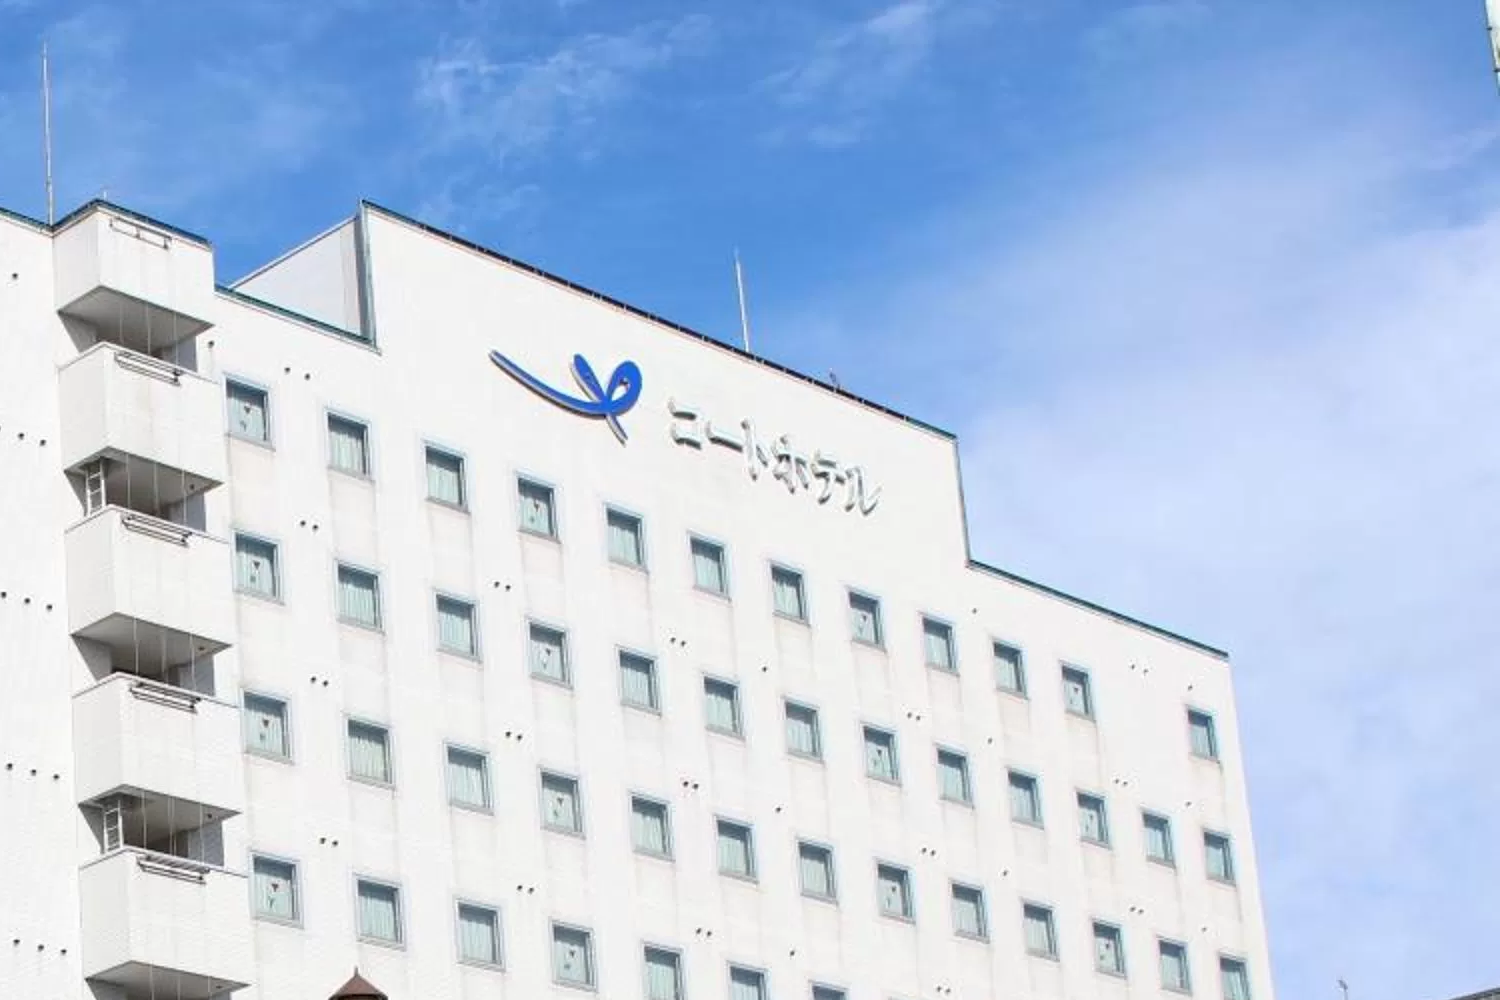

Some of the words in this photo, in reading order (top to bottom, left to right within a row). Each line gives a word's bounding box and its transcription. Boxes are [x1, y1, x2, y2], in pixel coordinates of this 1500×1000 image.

[666, 396, 883, 517] コートホテル
